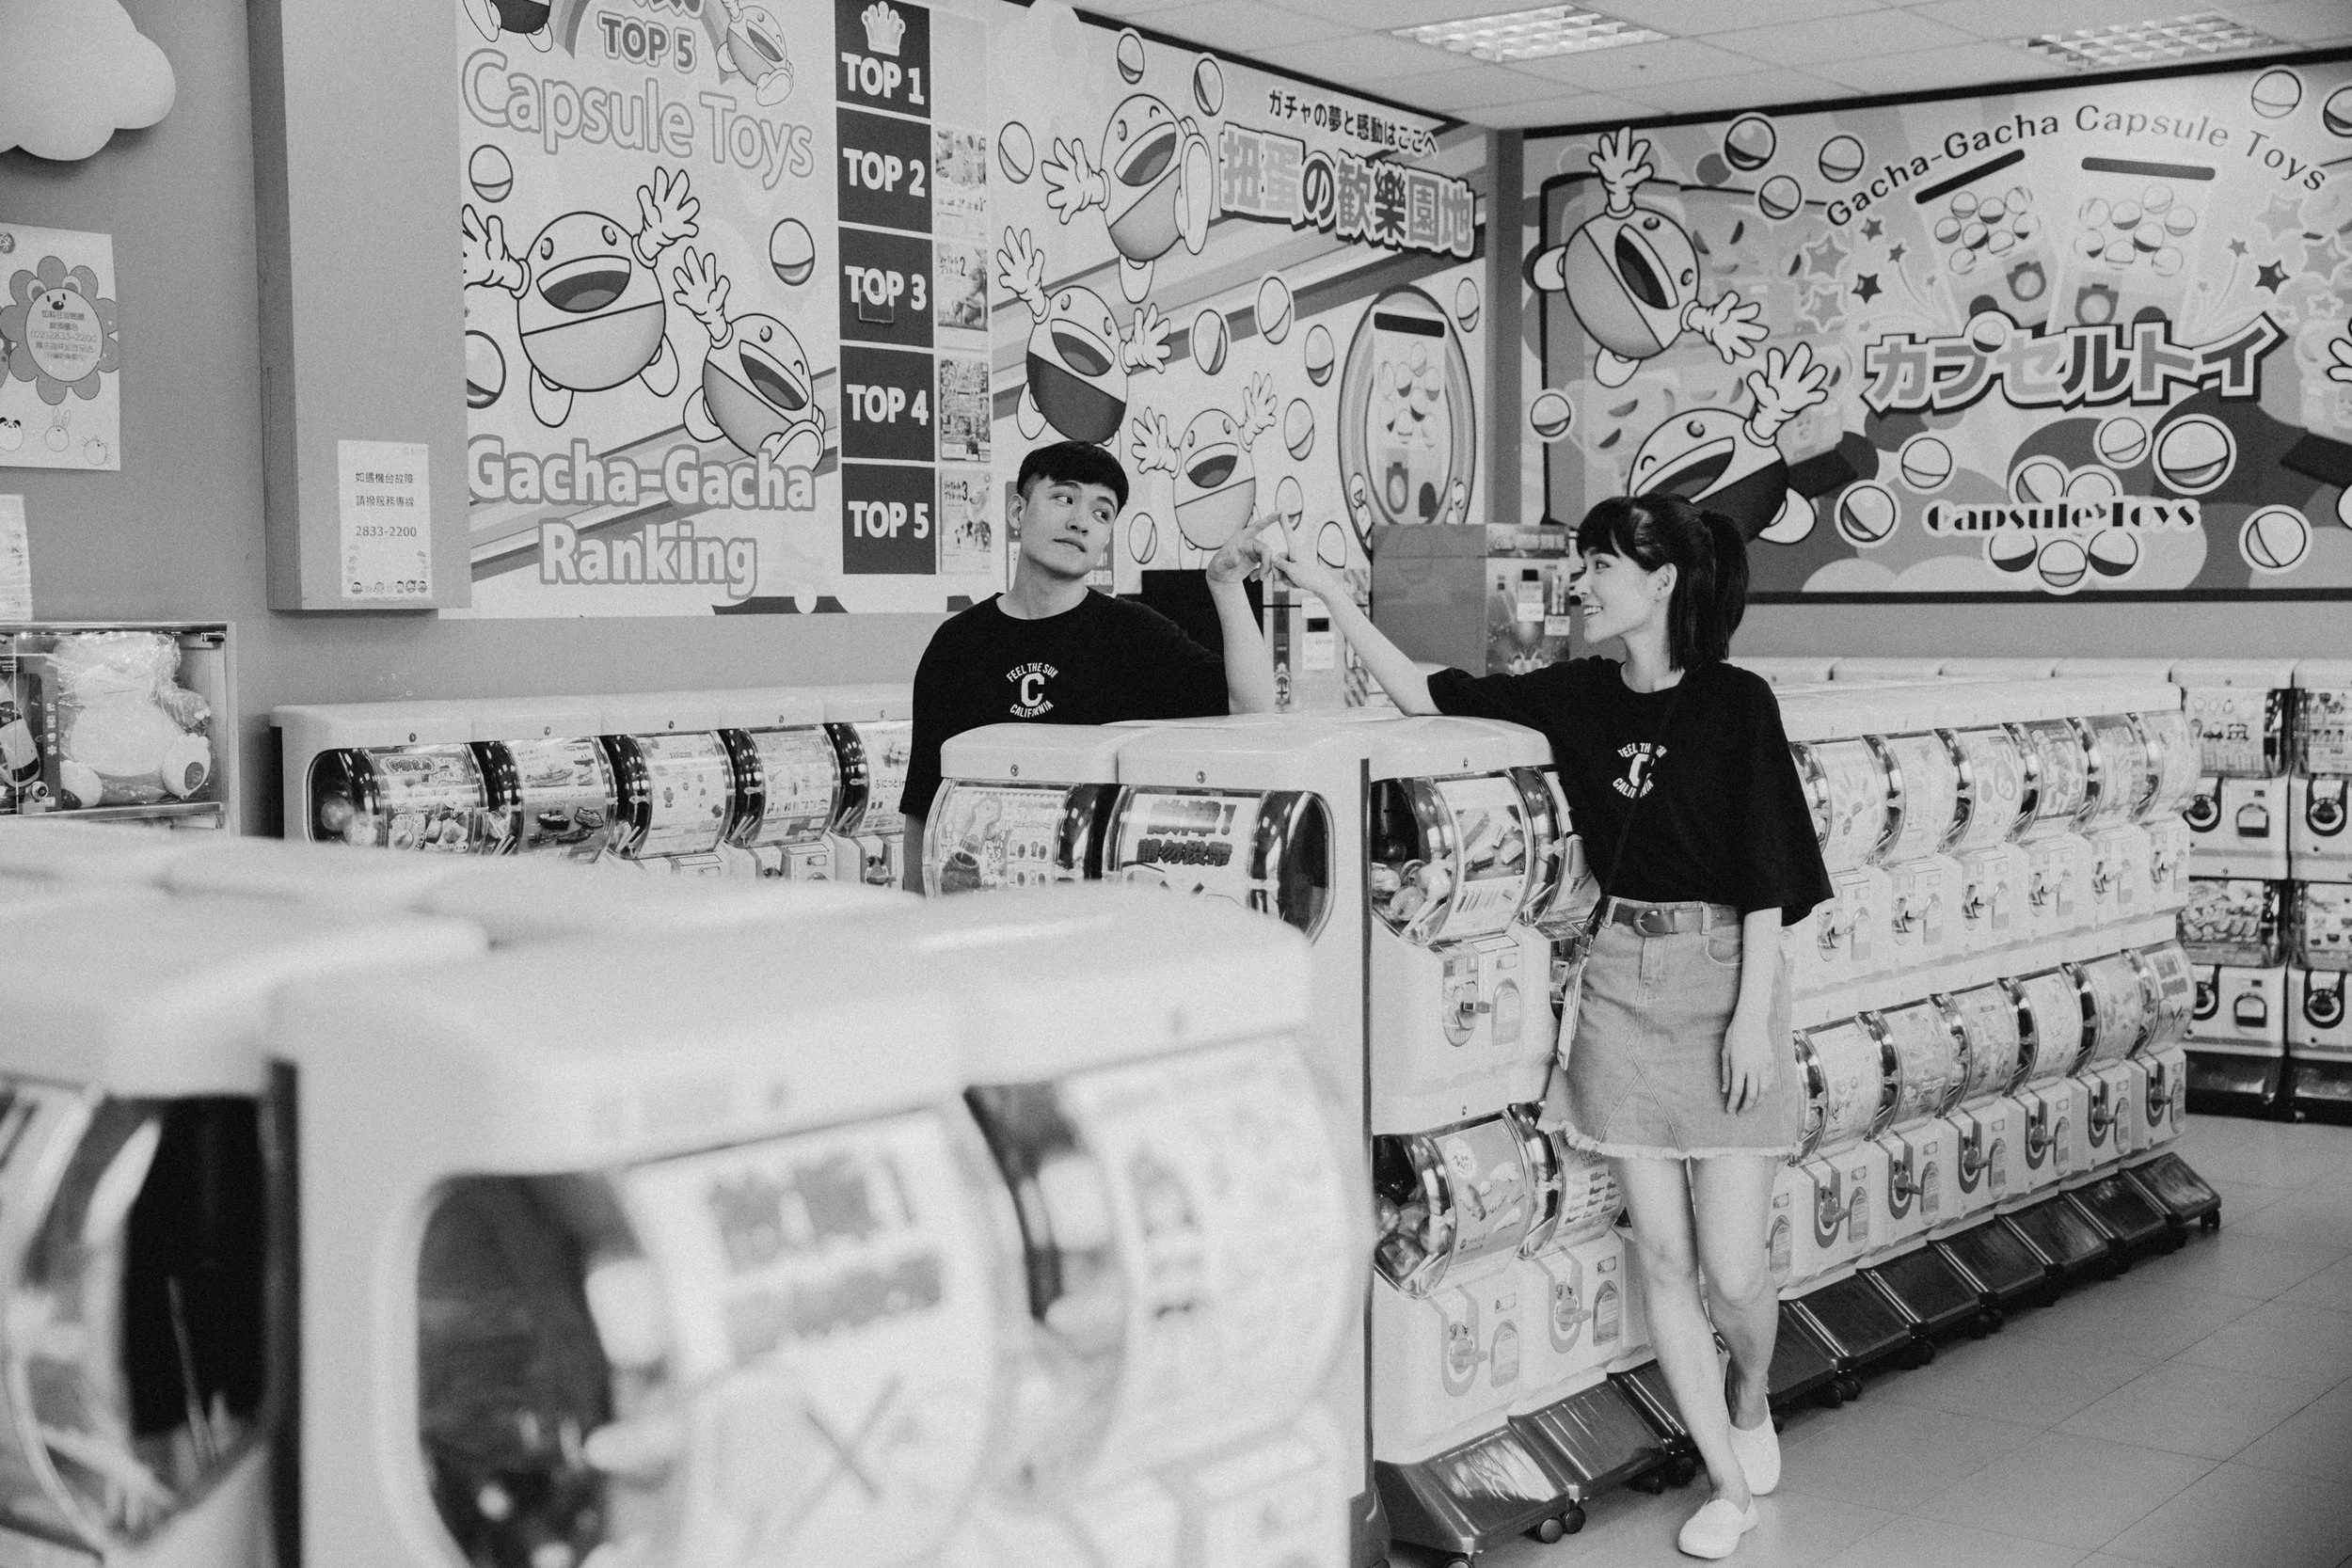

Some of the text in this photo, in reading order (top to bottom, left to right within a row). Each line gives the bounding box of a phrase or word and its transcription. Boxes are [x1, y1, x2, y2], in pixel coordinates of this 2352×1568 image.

[600, 15, 693, 69] TOP 5
[841, 52, 925, 104] TOP 1
[461, 48, 814, 190] Capsule Toys
[1269, 89, 1438, 155] ガチャの夢と感動はここへ
[842, 147, 926, 198] TOP 2
[1826, 104, 2327, 226] Gacha-Gacha Capsule Toys
[844, 265, 927, 311] TOP 3
[1865, 311, 2280, 410] カプセルトイ
[846, 384, 930, 426] TOP 4
[468, 435, 815, 511] Gacha-Gacha
[356, 526, 418, 538] 2833-2200
[848, 500, 930, 539] TOP 5
[1926, 502, 2098, 532] Capsule
[541, 519, 757, 599] Ranking
[1006, 665, 1027, 683] FEEL
[1027, 662, 1043, 673] THE
[1021, 672, 1045, 707] C
[1640, 742, 1652, 753] TH
